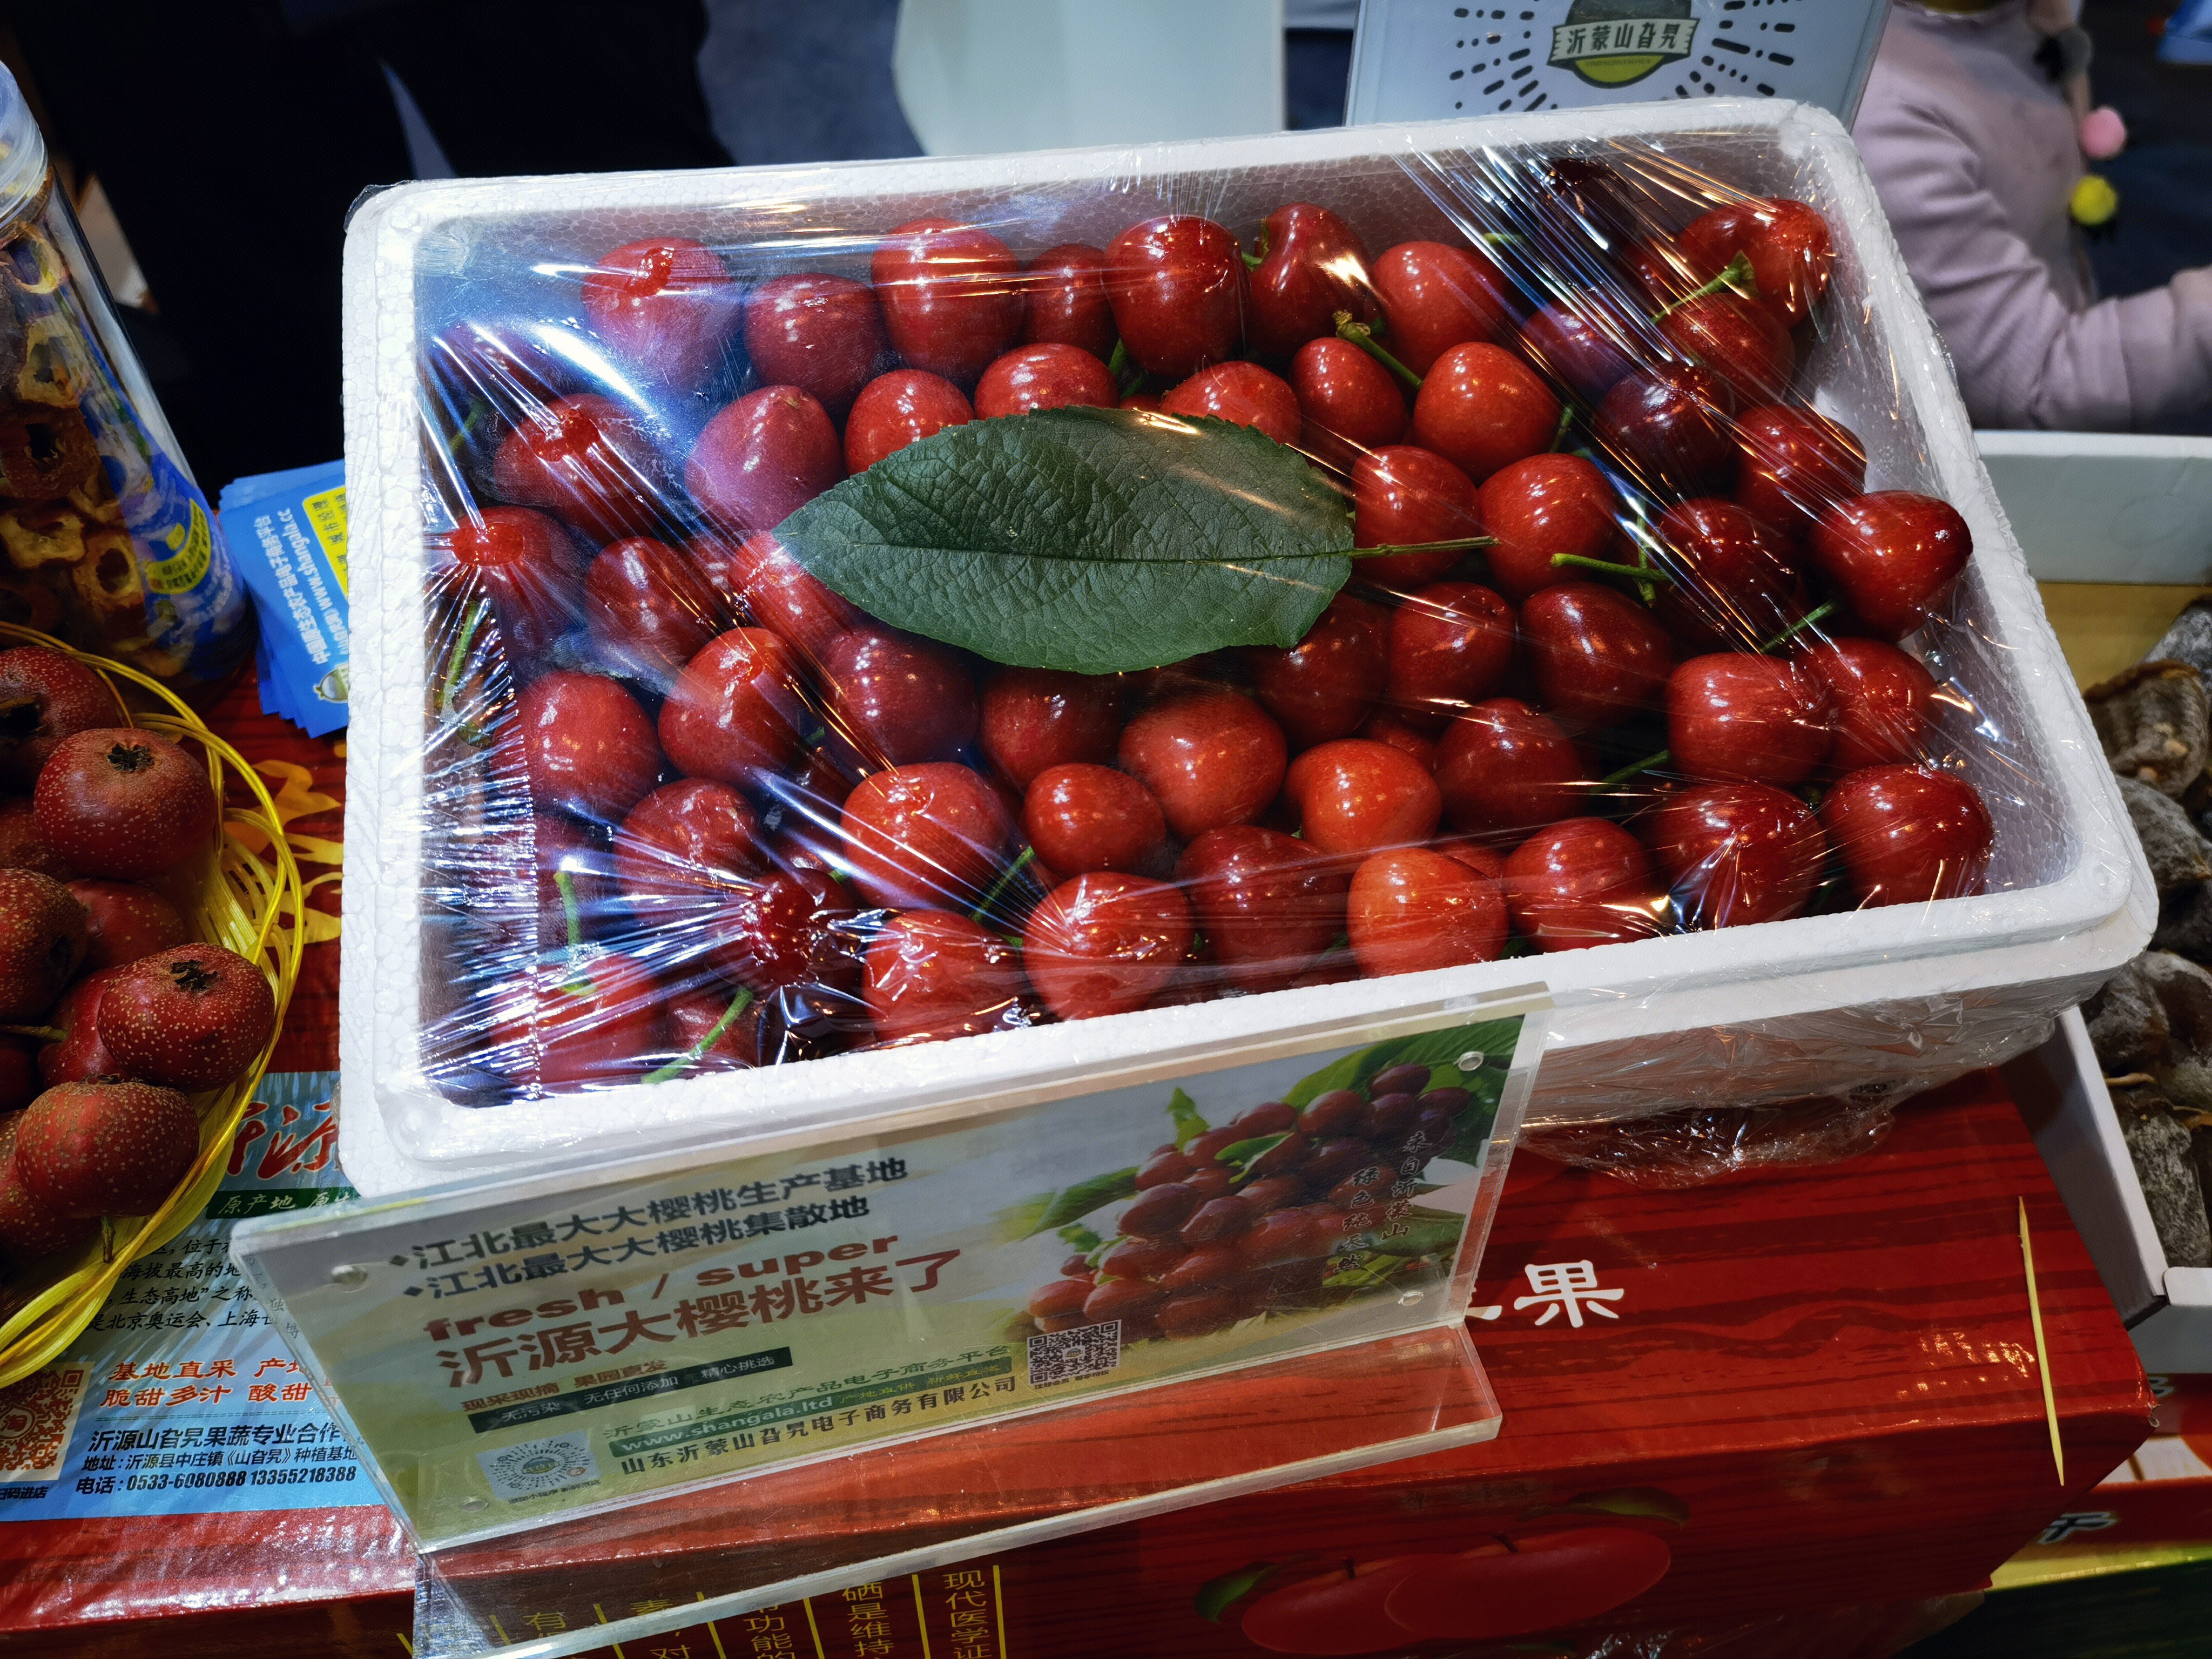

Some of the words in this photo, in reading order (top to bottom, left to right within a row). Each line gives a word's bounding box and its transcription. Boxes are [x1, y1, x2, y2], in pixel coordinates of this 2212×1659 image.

[1567, 22, 1681, 54] 沂蒙山旮旯
[218, 1194, 297, 1214] 原产地
[412, 1157, 908, 1269] 江北最大大樱桃生产基地
[426, 1196, 870, 1299] 江北最大大樱桃集散地
[423, 1289, 625, 1341] fresh
[696, 1235, 898, 1286] super
[436, 1249, 960, 1387] 沂源大樱桃来了
[100, 1385, 232, 1407] 脆甜多汁
[110, 1359, 238, 1380] 基地直采
[603, 1345, 1013, 1439] 沂蒙山生态农产品电子商务平台
[502, 1401, 560, 1422] 无污染
[584, 1376, 679, 1405] 无任何添加
[621, 1396, 833, 1452] www.shangala.ltd
[621, 1375, 1016, 1475] 山东沂蒙山旮旯电子商务有限公司
[89, 1422, 346, 1453] 沂源山旮旯果蔬专业合作
[250, 1466, 357, 1486] 13355218388
[841, 1581, 894, 1659] 硒是维持
